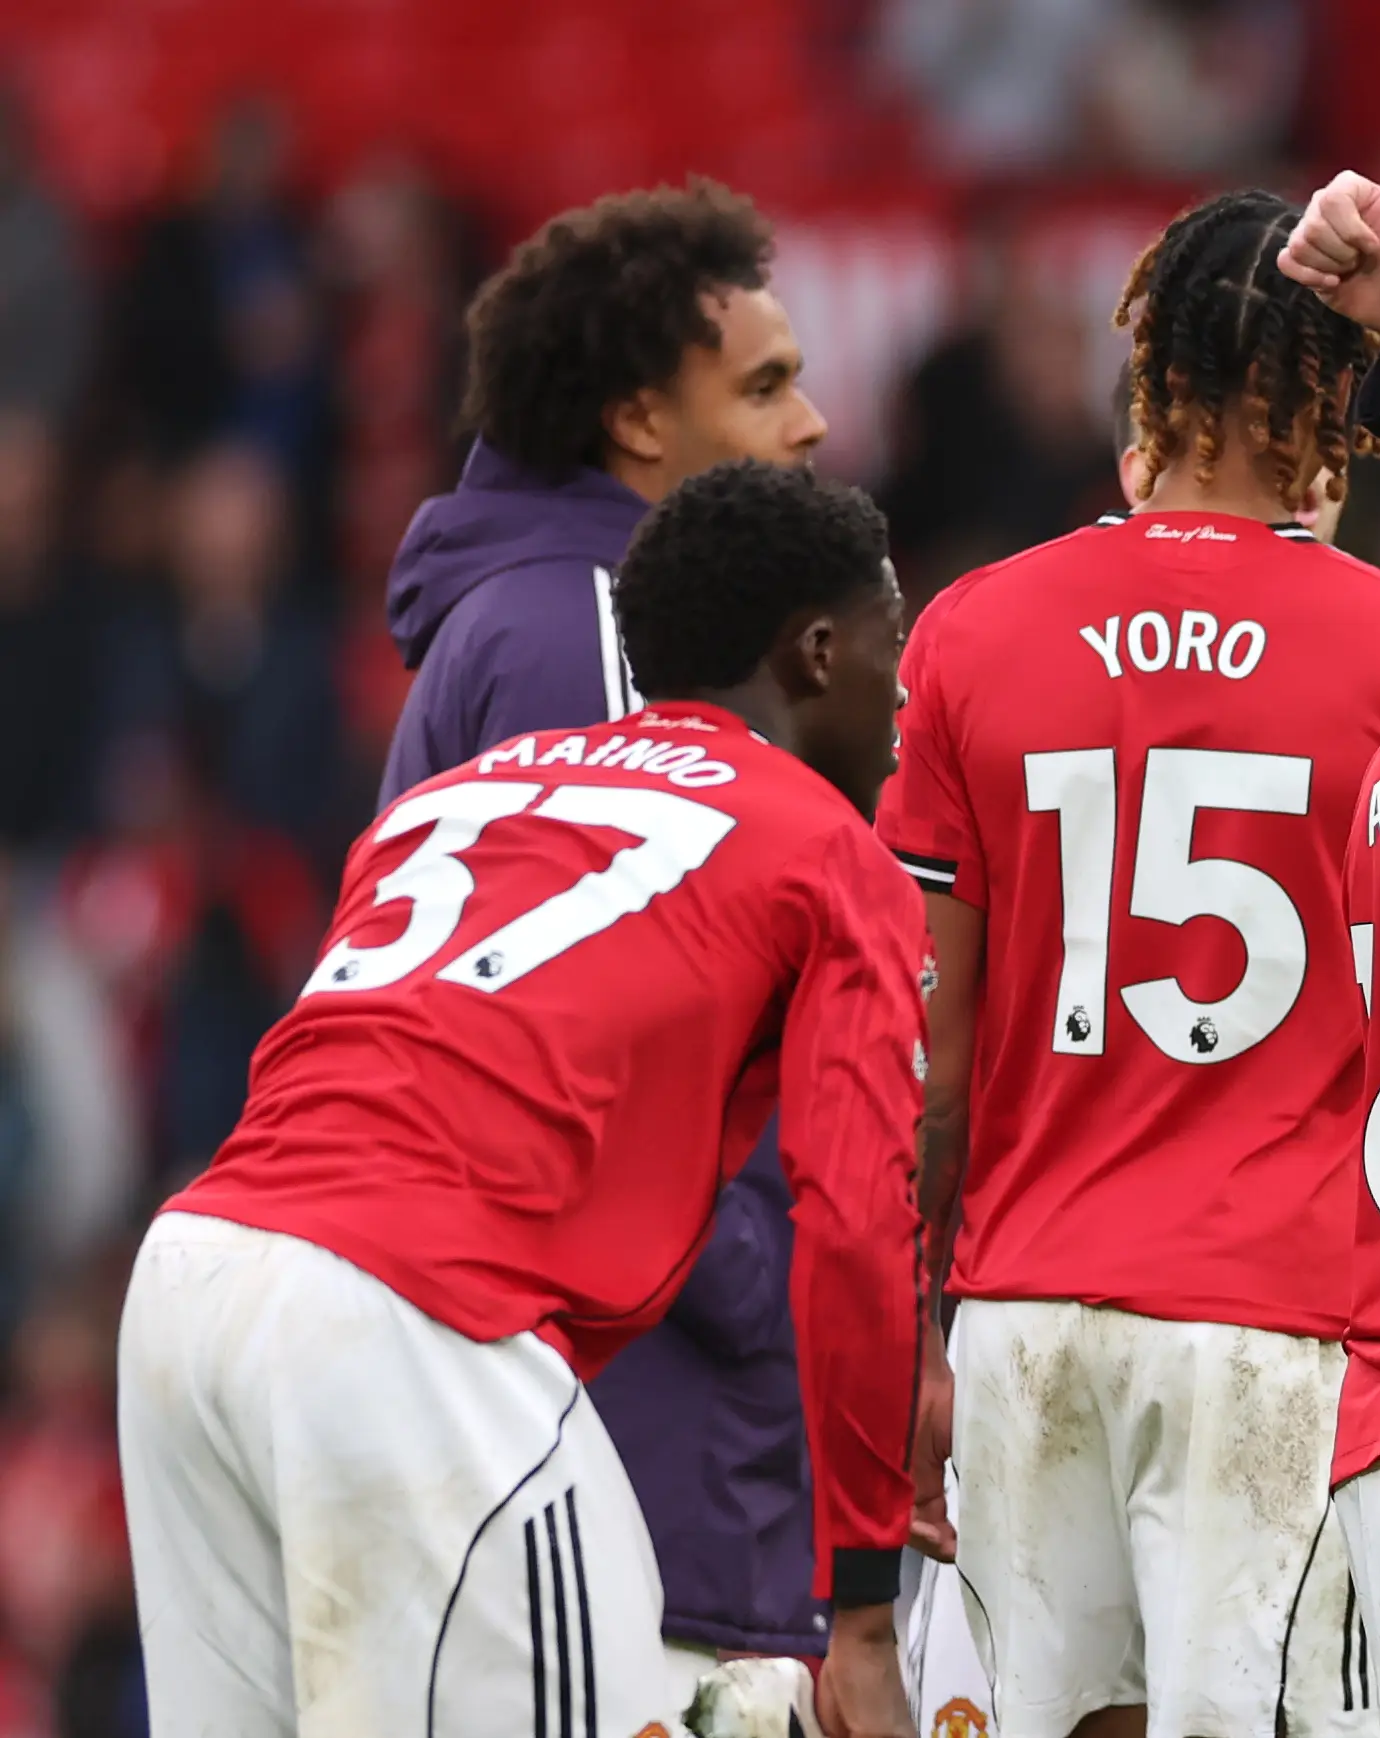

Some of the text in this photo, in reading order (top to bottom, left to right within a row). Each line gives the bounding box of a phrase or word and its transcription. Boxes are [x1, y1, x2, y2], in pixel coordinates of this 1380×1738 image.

[1079, 609, 1267, 680] YORO
[477, 734, 738, 789] MAINOO
[299, 780, 738, 1000] 37
[1023, 747, 1313, 1065] 15
